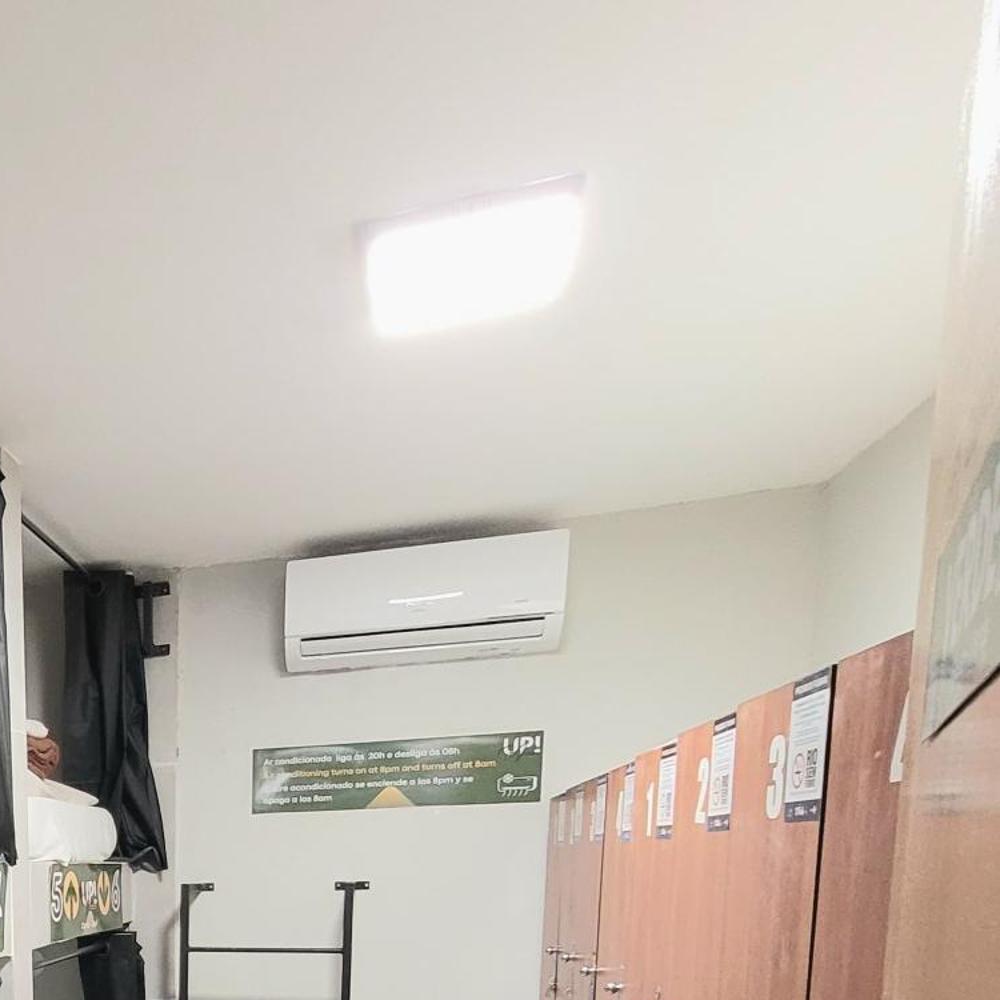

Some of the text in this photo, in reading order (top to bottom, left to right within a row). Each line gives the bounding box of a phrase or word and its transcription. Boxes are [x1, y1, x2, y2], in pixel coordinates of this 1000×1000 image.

[335, 753, 352, 763] liga
[367, 751, 385, 760] 20h
[386, 751, 393, 759] e
[394, 748, 428, 759] desliga
[503, 736, 541, 756] UP!
[355, 767, 367, 775] on
[368, 765, 378, 774] at
[401, 763, 420, 772] and
[421, 762, 446, 772] turns
[446, 760, 461, 770] off
[462, 760, 473, 769] at
[766, 734, 786, 819] 3
[290, 781, 353, 792] acondicionado
[417, 777, 432, 785] los
[454, 776, 462, 785] y
[299, 795, 312, 803] los
[694, 757, 709, 824] 2
[646, 781, 654, 837] 1
[51, 871, 64, 923] 5
[111, 868, 121, 912] 6
